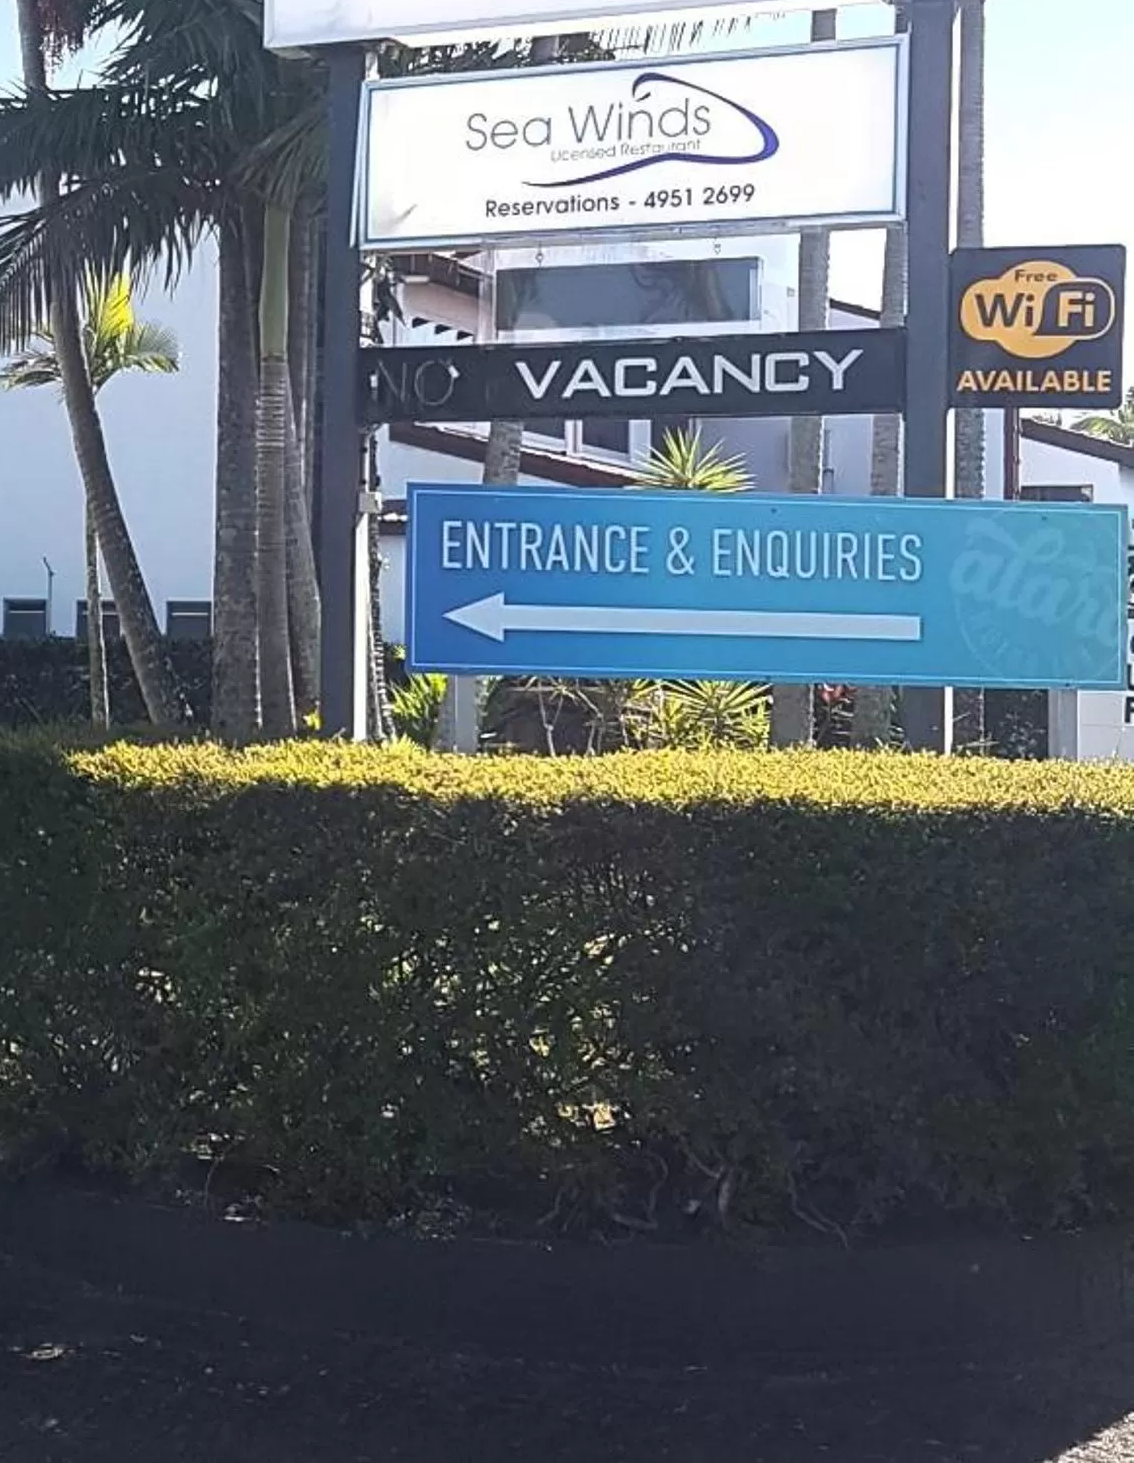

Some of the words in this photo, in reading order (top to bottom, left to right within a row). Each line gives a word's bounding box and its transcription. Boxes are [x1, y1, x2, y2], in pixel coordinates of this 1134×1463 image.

[465, 112, 552, 151] Sea
[568, 96, 712, 144] Winds
[550, 144, 616, 162] Licensed
[620, 138, 702, 157] Restaurant
[485, 194, 620, 218] Reservations
[643, 189, 693, 209] 4951
[702, 184, 756, 205] 2699
[1014, 269, 1059, 283] Free
[371, 358, 461, 406] NO
[514, 349, 864, 400] VACANCY
[956, 370, 1112, 392] AVAILABLE
[441, 519, 650, 574] ENTRANCE
[665, 526, 696, 576] &
[713, 527, 924, 583] ENQUIRIES
